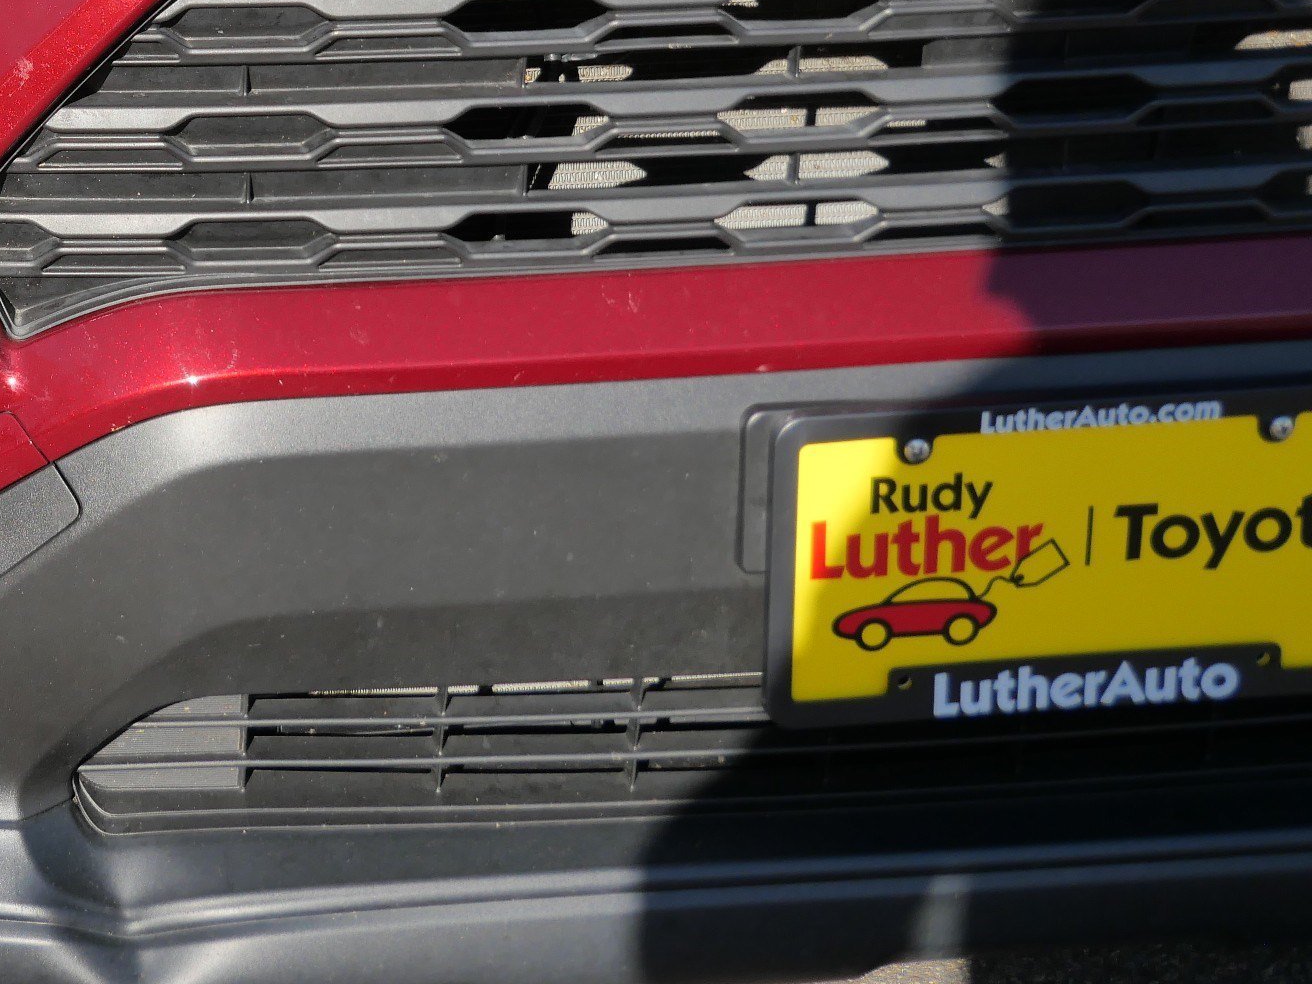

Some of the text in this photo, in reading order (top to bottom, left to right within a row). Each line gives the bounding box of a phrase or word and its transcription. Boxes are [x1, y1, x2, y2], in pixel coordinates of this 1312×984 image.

[980, 399, 1222, 434] LutherAuto.com
[870, 473, 993, 518] Rudy
[810, 514, 1044, 580] Luther
[933, 657, 1240, 718] LutherAuto
